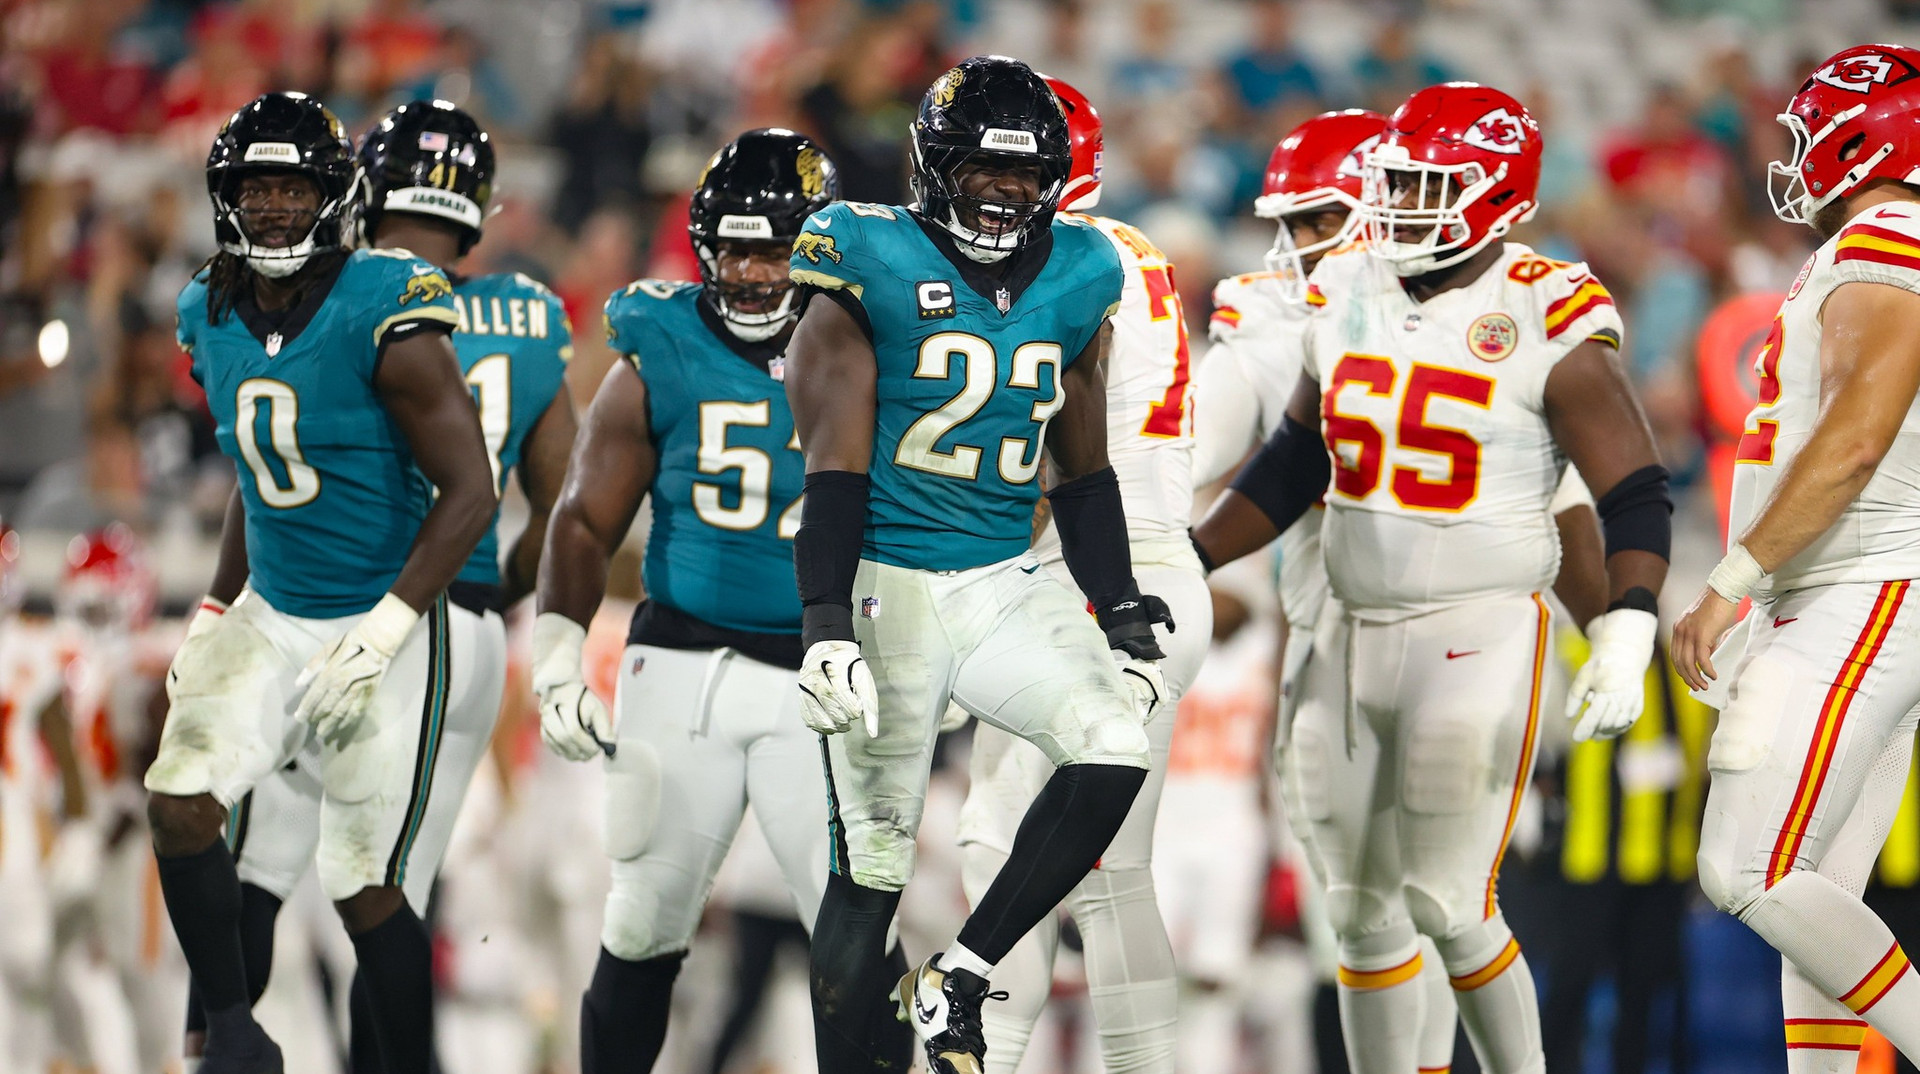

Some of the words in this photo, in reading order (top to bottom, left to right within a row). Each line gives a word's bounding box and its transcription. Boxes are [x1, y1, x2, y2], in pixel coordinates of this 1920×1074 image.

[428, 162, 457, 191] 41
[991, 132, 1030, 146] JAGUARS
[453, 293, 548, 339] ALLEN
[918, 282, 953, 310] C
[1140, 262, 1195, 439] 7
[234, 377, 322, 509] 0
[462, 353, 512, 500] 1
[894, 330, 1067, 486] 23
[1320, 351, 1498, 514] 65
